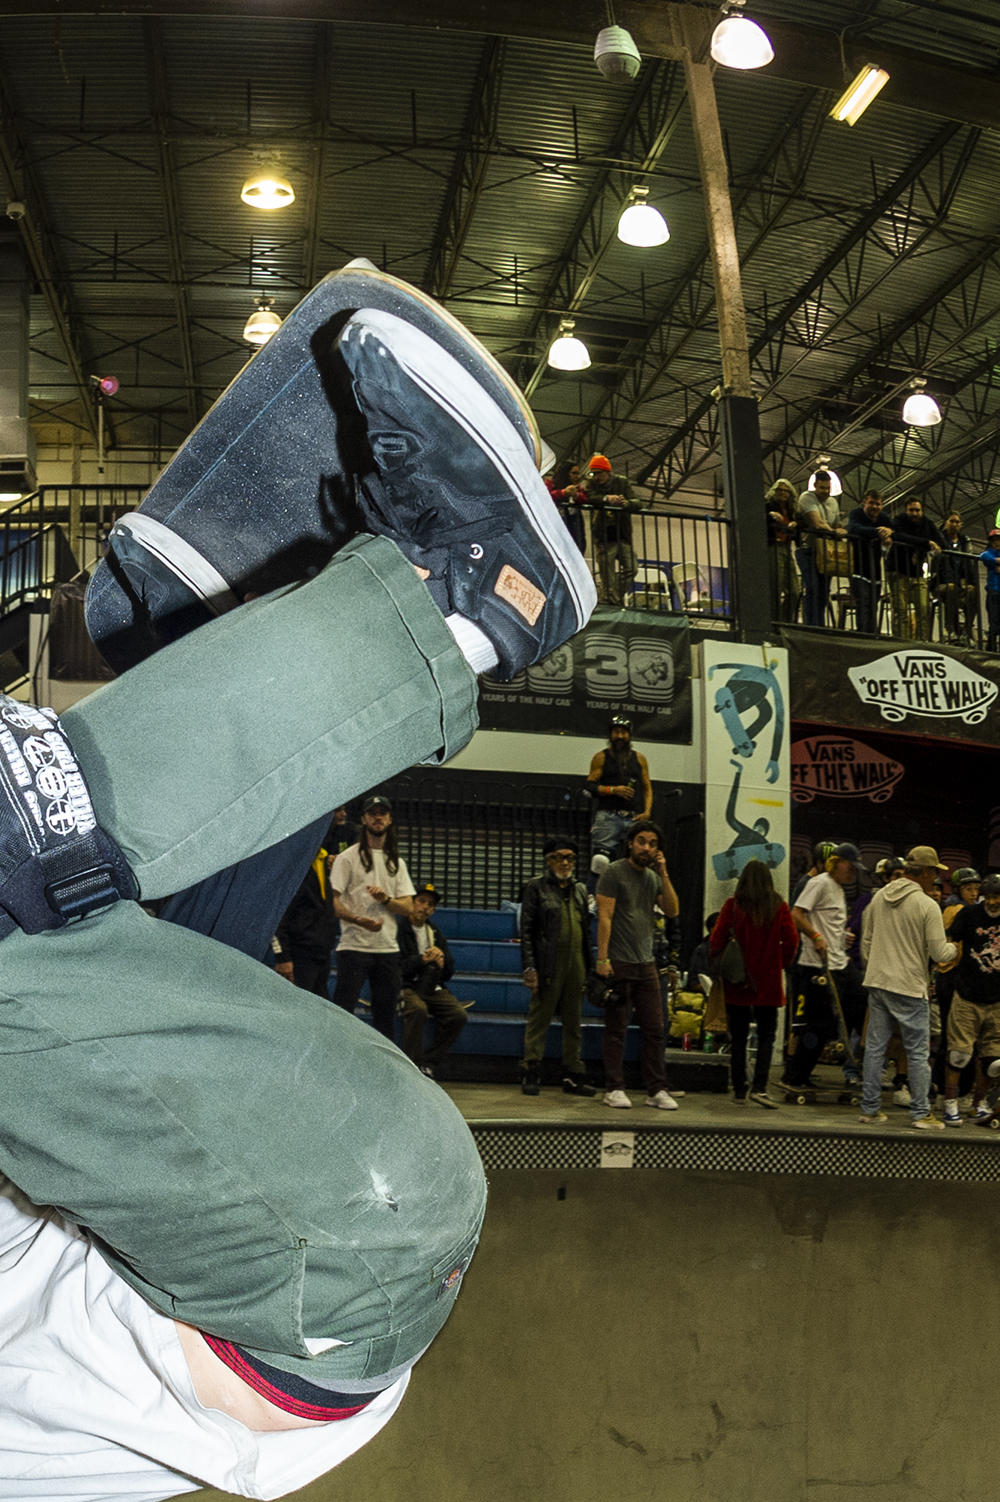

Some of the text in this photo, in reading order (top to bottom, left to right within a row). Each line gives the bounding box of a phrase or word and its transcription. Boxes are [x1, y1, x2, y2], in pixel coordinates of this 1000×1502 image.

[893, 655, 947, 679] VANS
[481, 692, 505, 703] YEARS
[506, 693, 517, 703] OF
[519, 694, 534, 704] THE
[535, 695, 553, 706] HALF
[859, 676, 991, 710] "OFF THE WALL"
[585, 700, 609, 710] YEARS
[610, 701, 620, 711] OF
[622, 702, 636, 712] THE
[637, 704, 655, 714] HALF
[804, 740, 856, 762] VANS
[791, 762, 898, 791] FF THE WALL"
[64, 772, 97, 836] KILLER
